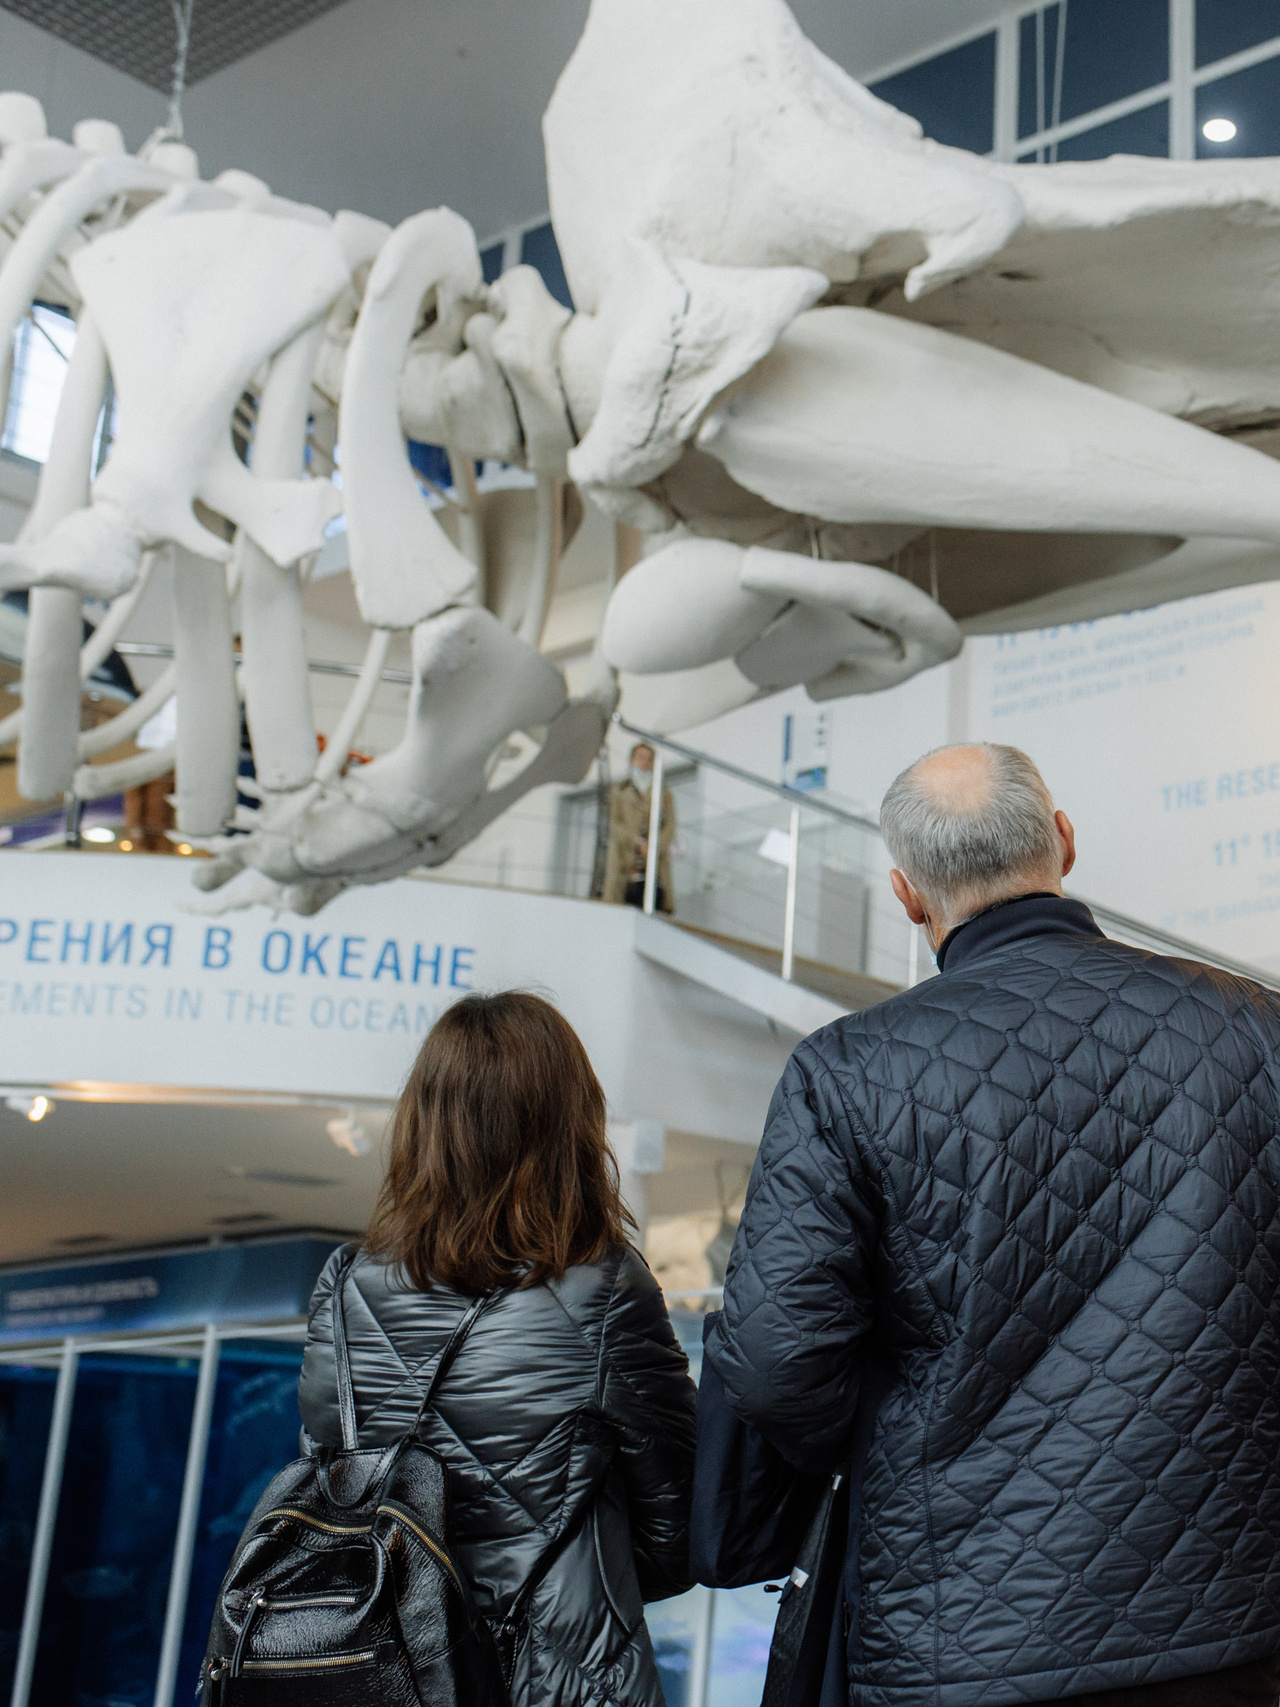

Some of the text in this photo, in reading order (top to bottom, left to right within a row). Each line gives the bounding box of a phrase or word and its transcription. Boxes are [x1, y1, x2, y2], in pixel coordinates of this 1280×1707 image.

[1161, 778, 1207, 812] THE
[202, 926, 232, 970] В
[262, 929, 476, 990] ОКЕАНЕ
[0, 981, 437, 1035] MENTS IN THE OCEAN
